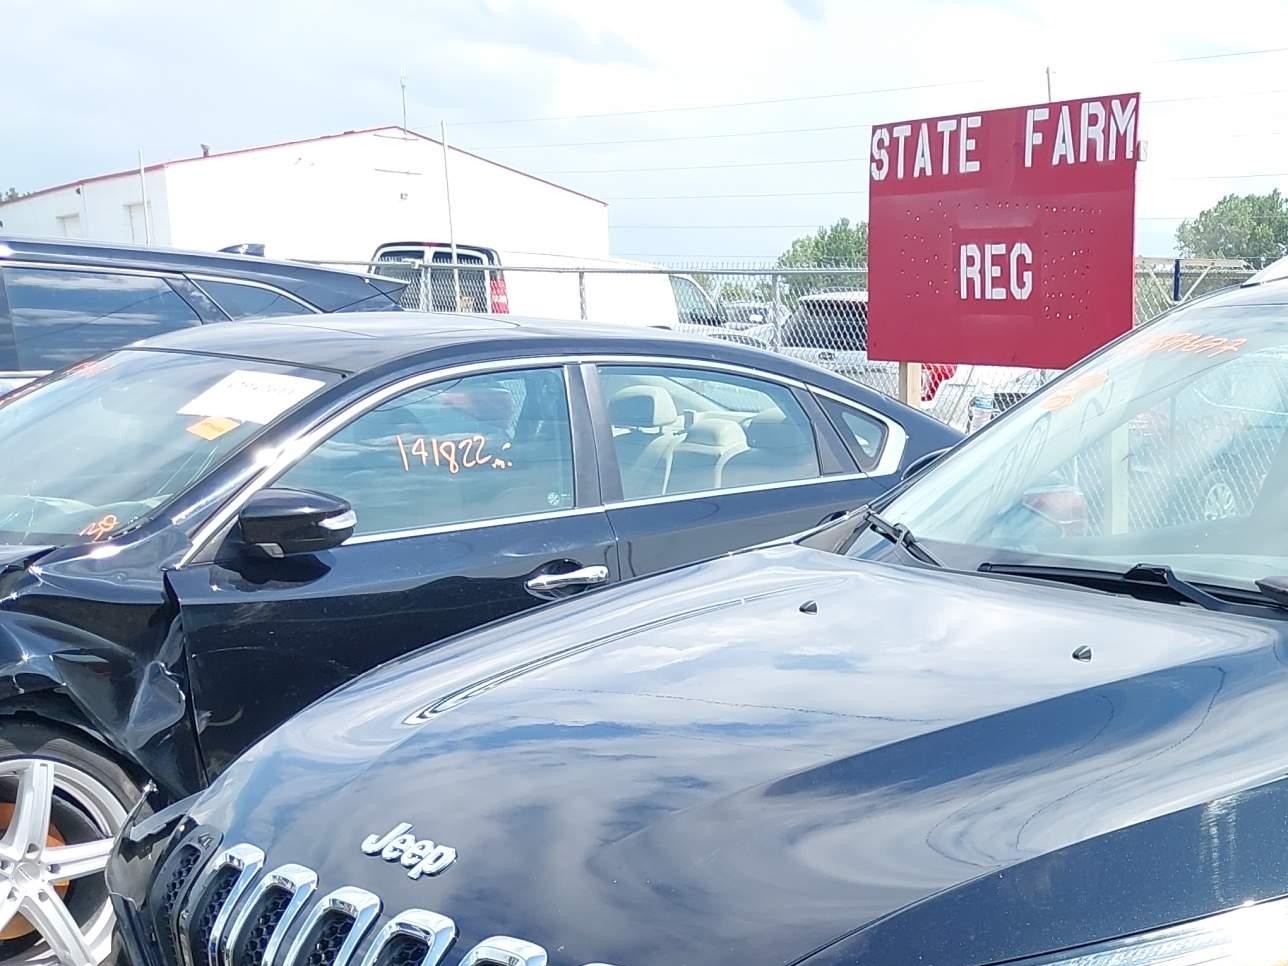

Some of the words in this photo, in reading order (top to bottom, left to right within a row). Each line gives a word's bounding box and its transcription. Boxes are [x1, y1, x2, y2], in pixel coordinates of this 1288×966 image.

[871, 115, 982, 181] STATE
[1024, 97, 1137, 168] FARM
[960, 242, 1033, 300] REG
[361, 822, 456, 879] Jeep
